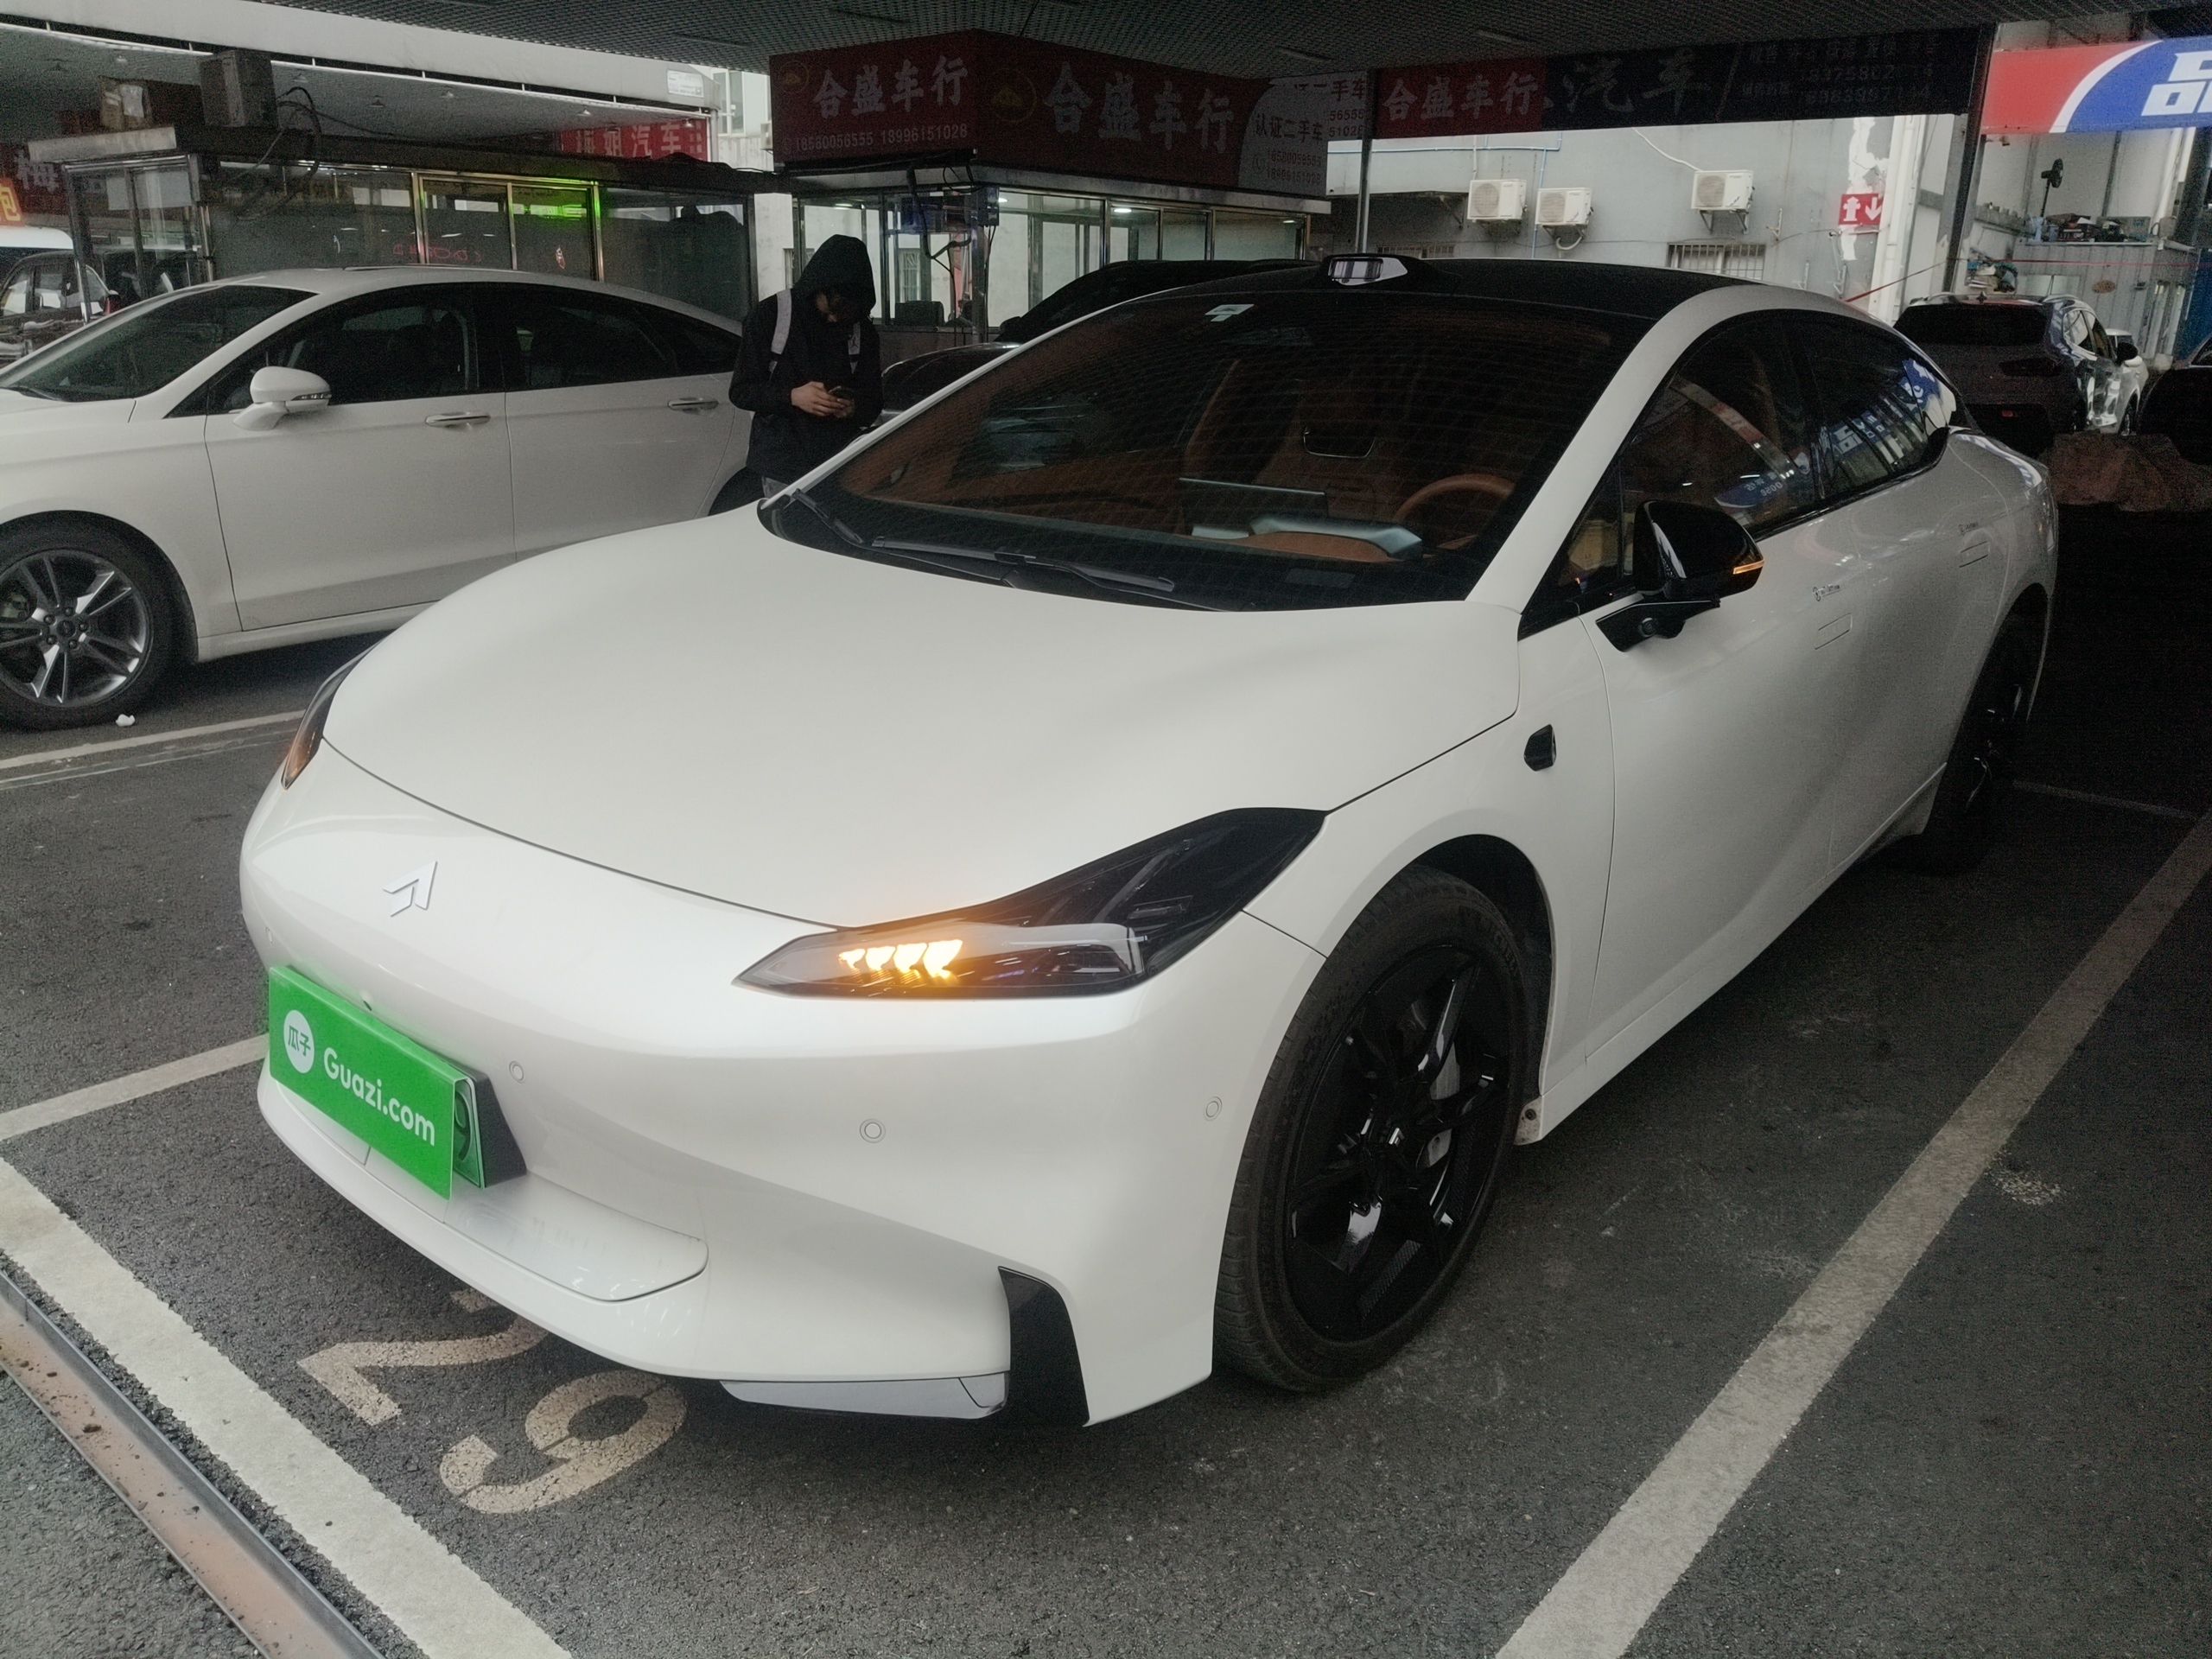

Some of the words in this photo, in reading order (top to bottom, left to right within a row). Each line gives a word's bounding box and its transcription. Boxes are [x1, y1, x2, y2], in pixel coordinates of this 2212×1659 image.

[813, 55, 969, 119] 合盛车行
[1044, 61, 1236, 154] 合盛车行
[1382, 71, 1539, 121] 合盛车行
[1543, 54, 1709, 115] 汽车
[796, 132, 874, 151] 18580056555
[881, 124, 968, 144] 18996151028
[1255, 113, 1324, 143] 认证二手车
[288, 1026, 311, 1057] 瓜子
[323, 1046, 435, 1147] Guazi.com
